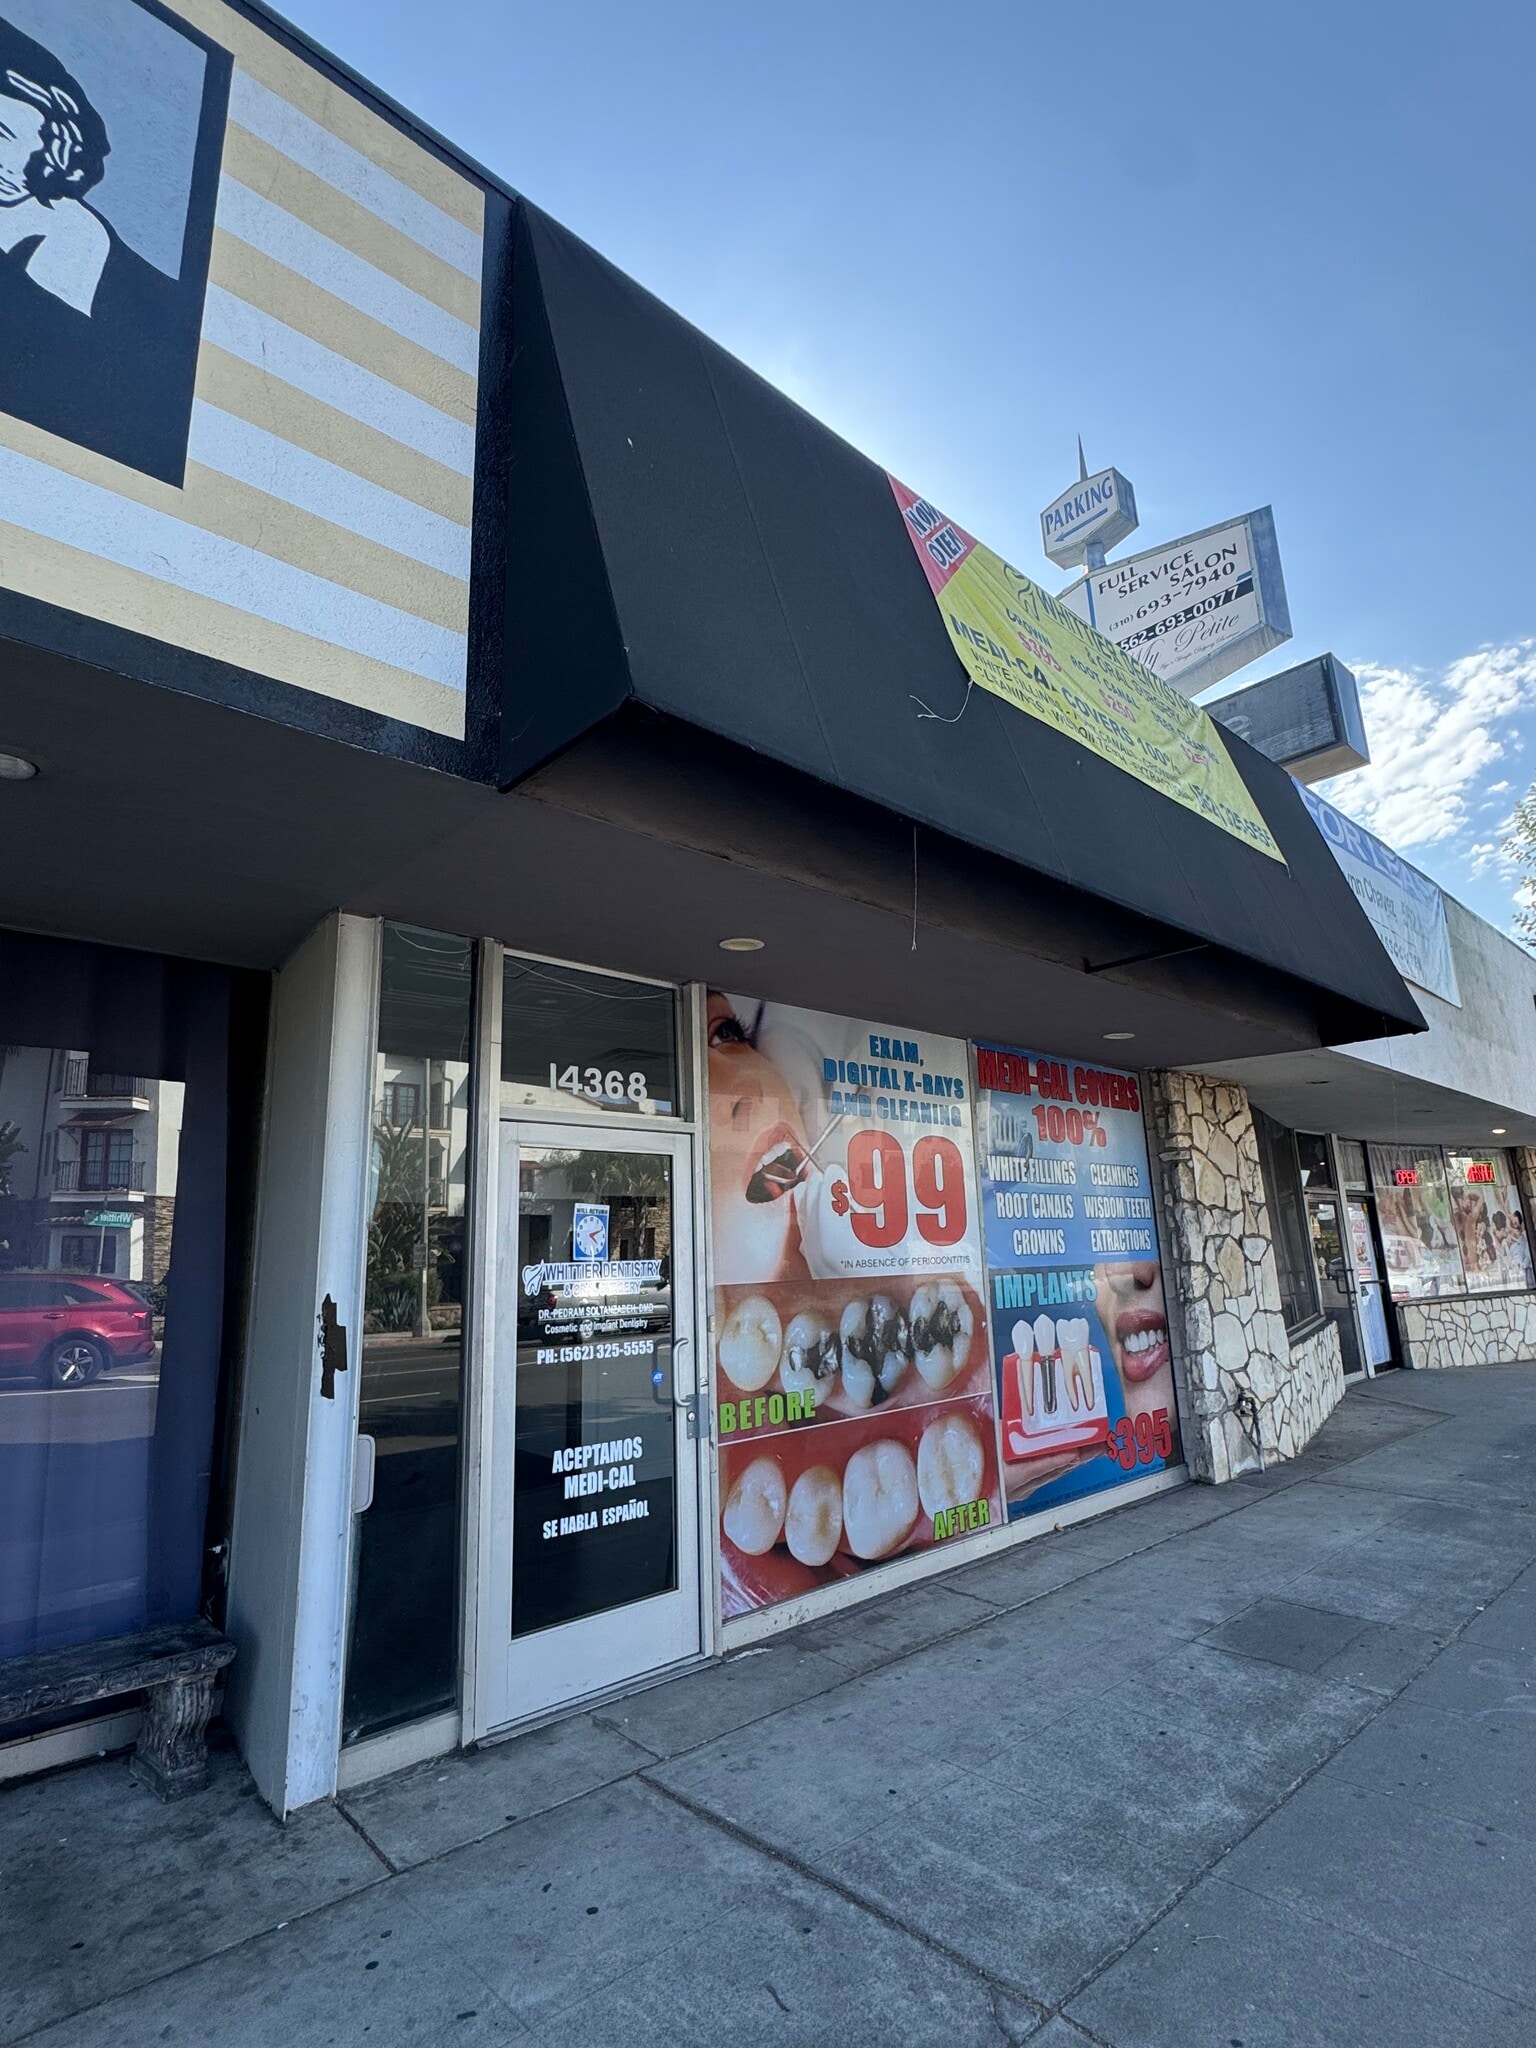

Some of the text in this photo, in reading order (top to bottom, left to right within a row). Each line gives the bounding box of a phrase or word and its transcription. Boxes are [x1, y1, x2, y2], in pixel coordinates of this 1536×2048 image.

[1045, 476, 1114, 535] PARKING
[1098, 567, 1139, 595] FULL
[1119, 550, 1194, 599] SERVICE
[1170, 543, 1238, 587] SALON
[1109, 561, 1235, 632] (310) 693-7940
[1034, 586, 1123, 669] WHITTIER
[1120, 584, 1239, 651] 562-693-0077
[1174, 614, 1240, 652] Petite
[1062, 687, 1135, 746] COVERS
[869, 1034, 924, 1067] EXAM,
[550, 1062, 648, 1103] 14368
[823, 1058, 964, 1099] DIGITAL X-RAYS
[977, 1047, 1140, 1112] MEDI-CAL COVERS
[831, 1091, 962, 1127] AND CLEANING
[1032, 1104, 1107, 1148] 100%
[987, 1155, 1077, 1185] WHITE FILLINGS
[1090, 1163, 1140, 1187] CLEANINGS
[1396, 1171, 1418, 1184] OPEN
[996, 1192, 1075, 1219] ROOT CANALS
[1083, 1195, 1151, 1219] WISDOM TEETH
[1013, 1229, 1065, 1256] CROWNS
[1091, 1229, 1151, 1252] EXTRACTIONS
[544, 1260, 661, 1281] WHITTIER DENTISTRY
[855, 1257, 897, 1268] ABSENCE
[898, 1257, 910, 1266] OF
[911, 1255, 971, 1266] PERIODONTITIS
[563, 1283, 572, 1298] &
[995, 1271, 1097, 1309] IMPLANTS
[544, 1318, 649, 1335] Cosmetic and Implant Dentistry
[553, 1306, 585, 1318] PEDRAM
[537, 1340, 654, 1365] PH: (562) 325-5555
[719, 1388, 817, 1434] BEFORE
[552, 1436, 643, 1473] ACEPTAMOS
[1105, 1407, 1172, 1471] $395
[564, 1464, 636, 1500] MEDI-CAL
[542, 1498, 649, 1539] SE HABLA ESPAÑOL
[933, 1498, 991, 1542] AFTER
